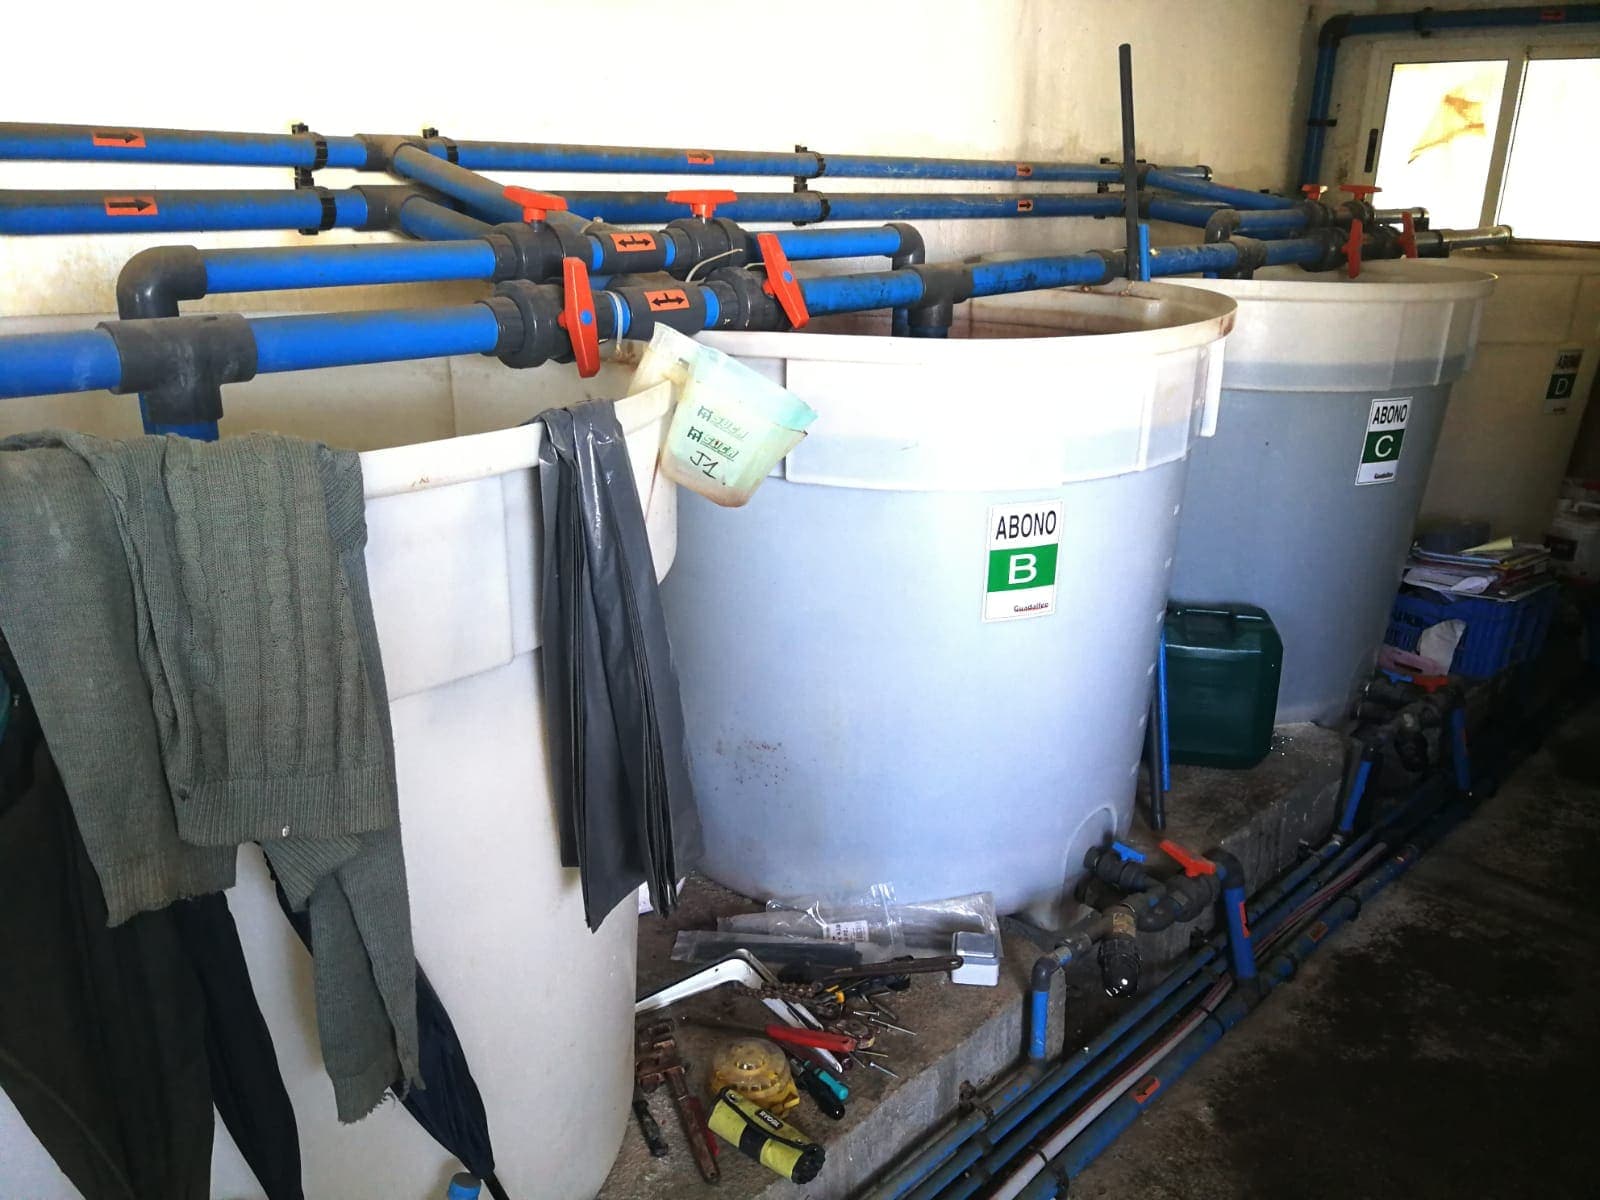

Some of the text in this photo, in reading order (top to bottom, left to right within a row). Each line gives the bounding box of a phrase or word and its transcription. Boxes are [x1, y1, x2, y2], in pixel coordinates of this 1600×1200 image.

[1555, 378, 1569, 396] D
[1372, 404, 1408, 424] ABONO
[1374, 434, 1394, 458] C
[995, 510, 1057, 540] ABONO
[1008, 553, 1038, 585] B
